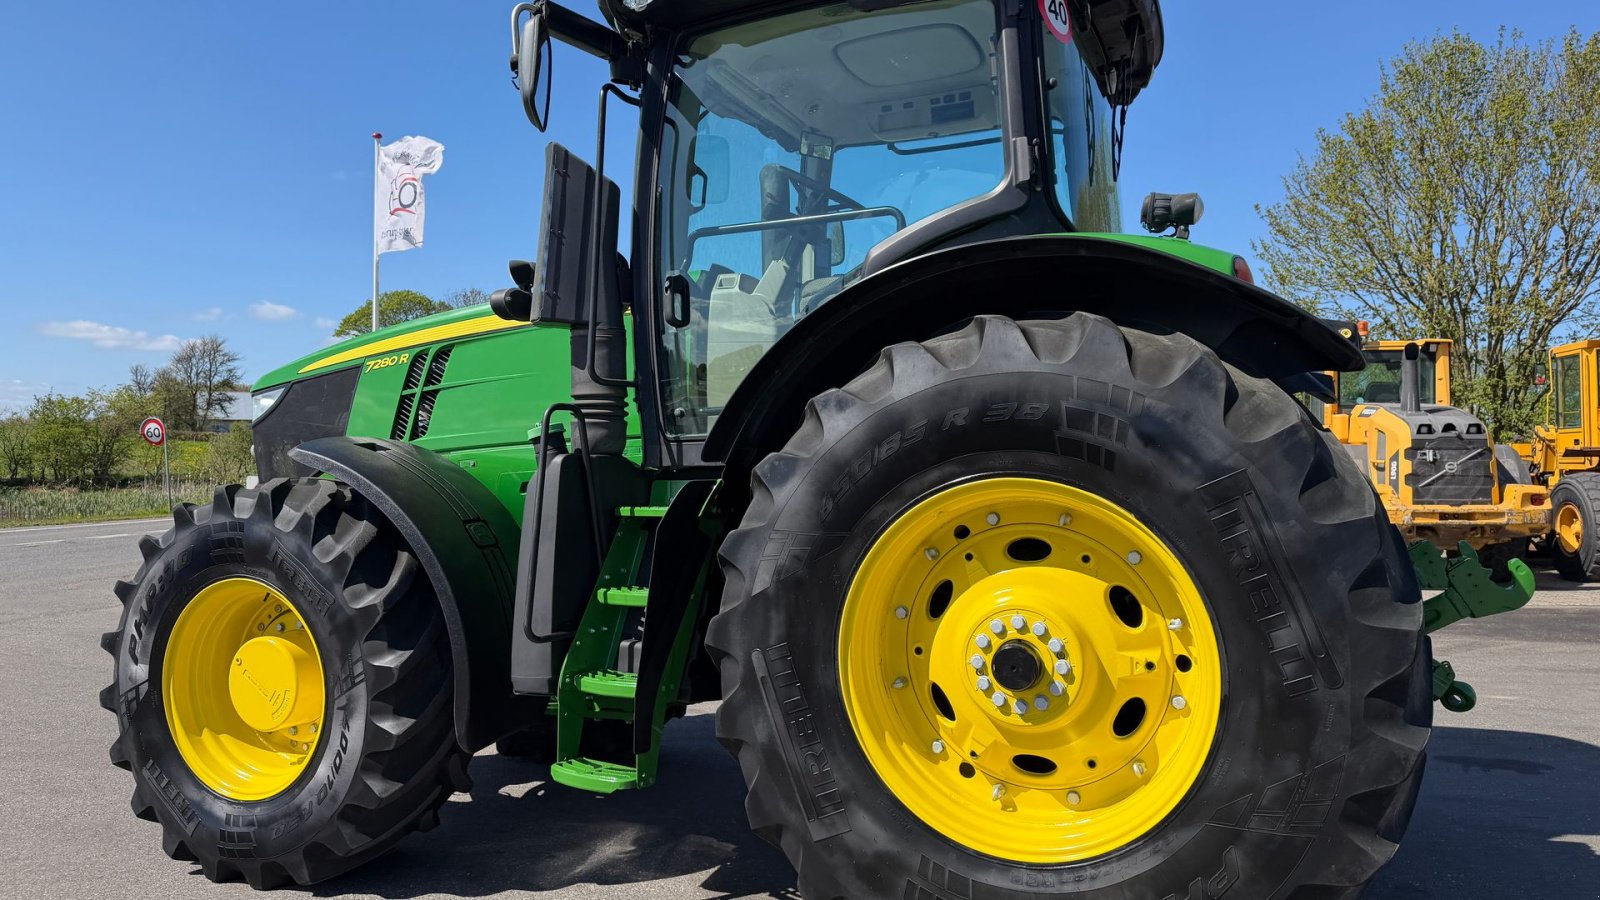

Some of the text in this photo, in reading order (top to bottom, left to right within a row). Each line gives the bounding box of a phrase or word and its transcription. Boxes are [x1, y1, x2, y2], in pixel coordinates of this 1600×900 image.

[1048, 0, 1067, 26] 40
[365, 353, 410, 374] 7280 R
[942, 406, 971, 432] R
[982, 402, 1051, 422] 38
[146, 427, 161, 438] 60
[1196, 467, 1344, 697] PIRELLI
[751, 642, 852, 843] PIRELLI
